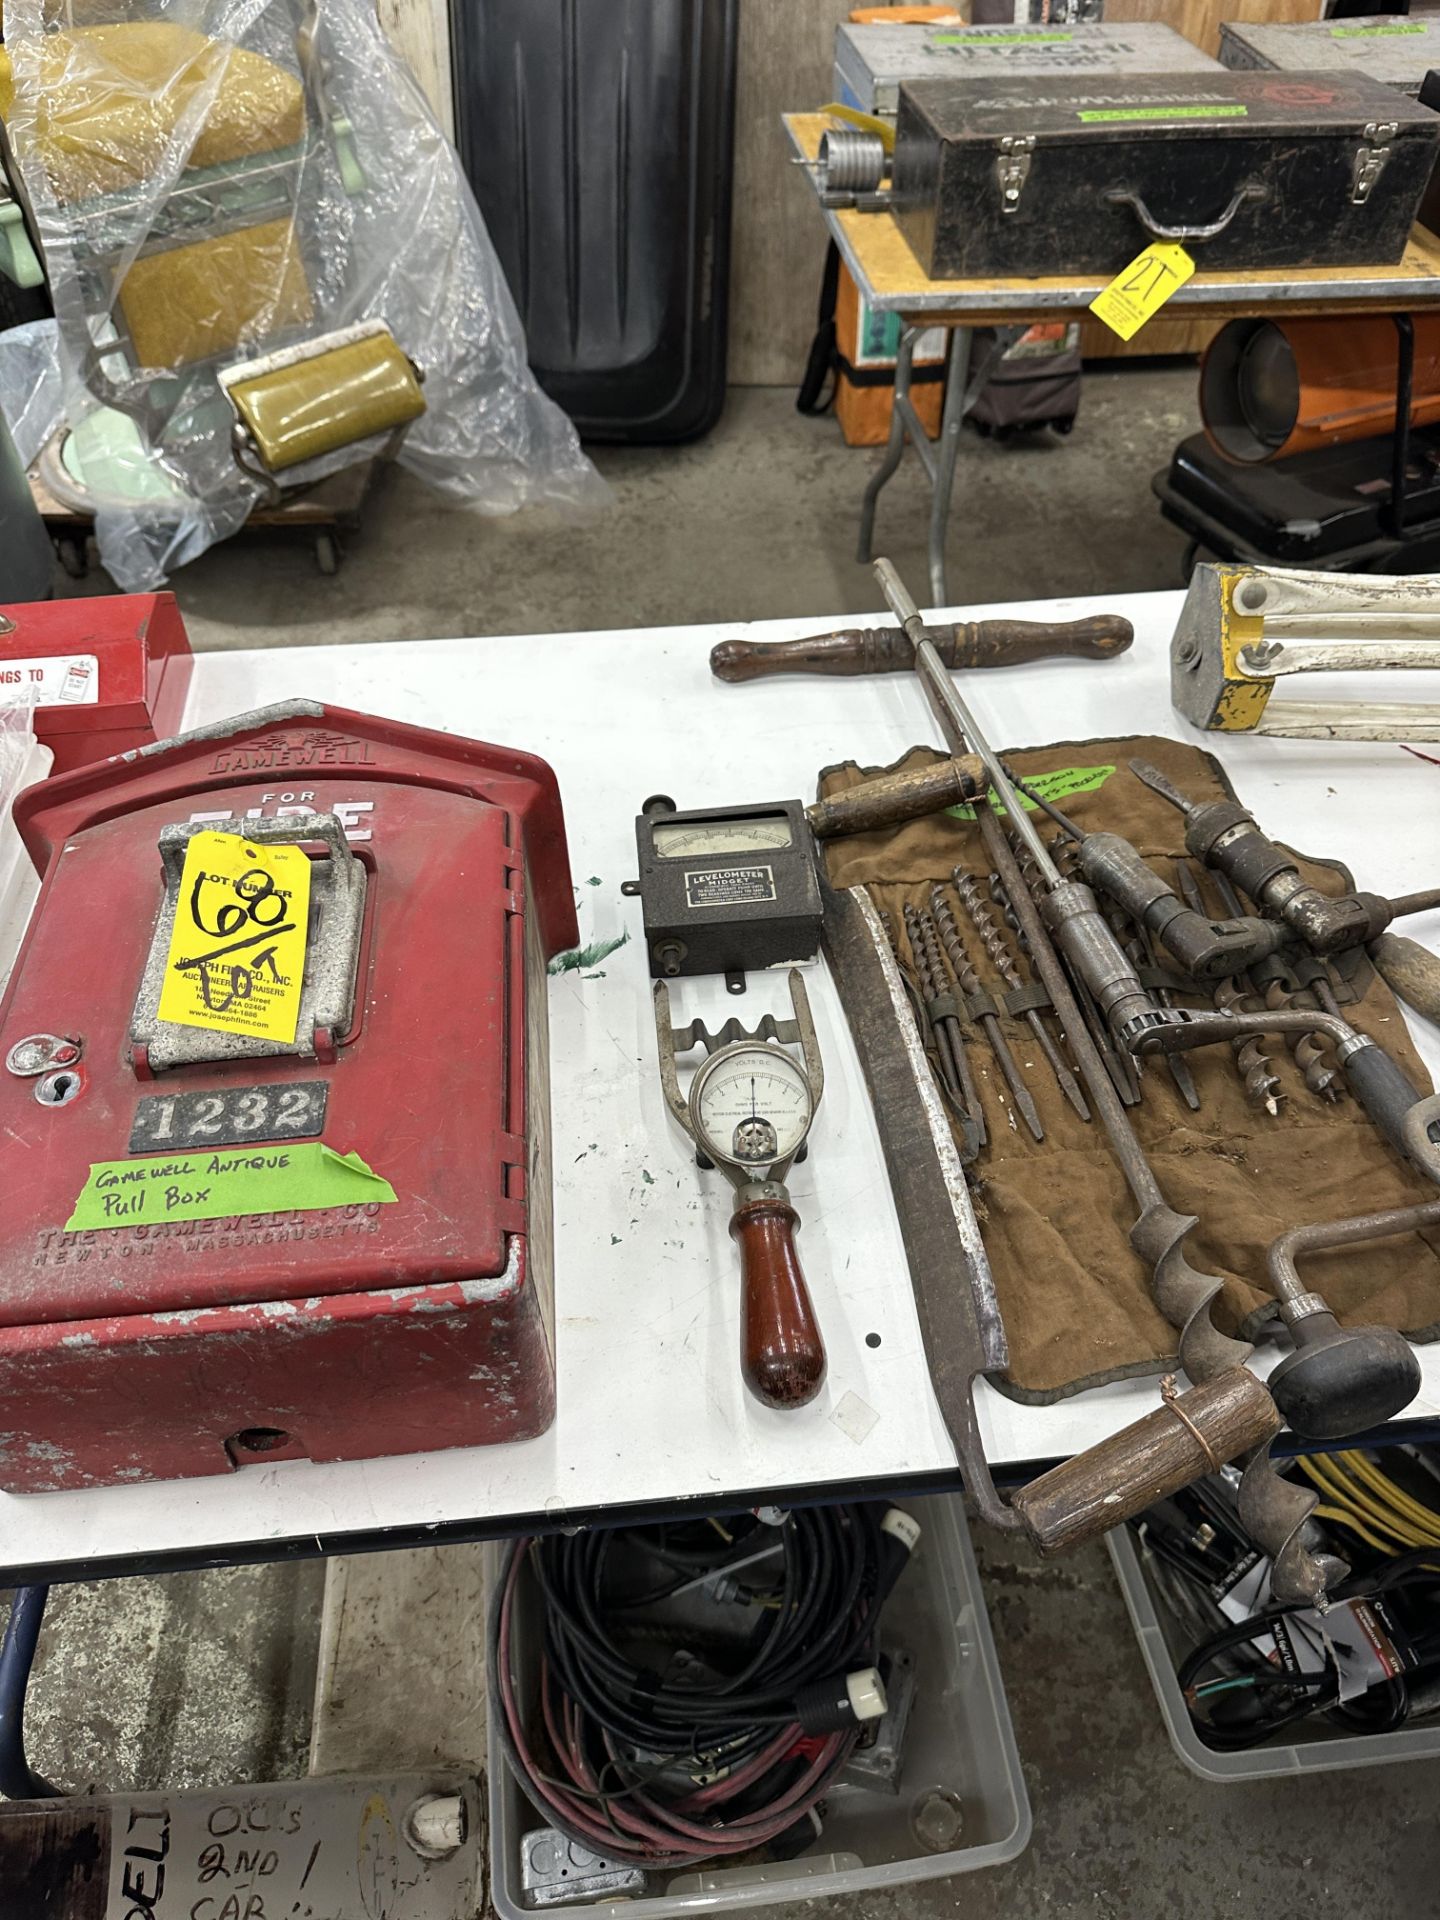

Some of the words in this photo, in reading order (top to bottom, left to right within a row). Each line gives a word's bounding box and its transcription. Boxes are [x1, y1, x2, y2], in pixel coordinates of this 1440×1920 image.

[28, 668, 44, 682] TO
[208, 743, 376, 775] GAMEWELL
[261, 791, 316, 804] FOR
[693, 871, 764, 884] LEVELOMETER
[708, 877, 750, 886] MIDGET
[188, 1008, 270, 1029] www.josephfinn.com
[151, 1089, 311, 1141] 1232
[206, 1153, 292, 1176] ANTIQUE
[102, 1189, 145, 1217] Pull
[164, 1187, 211, 1211] Box
[34, 1243, 154, 1267] NEWTON
[185, 1221, 379, 1252] MASSACHUSETTS
[37, 1227, 97, 1250] THE
